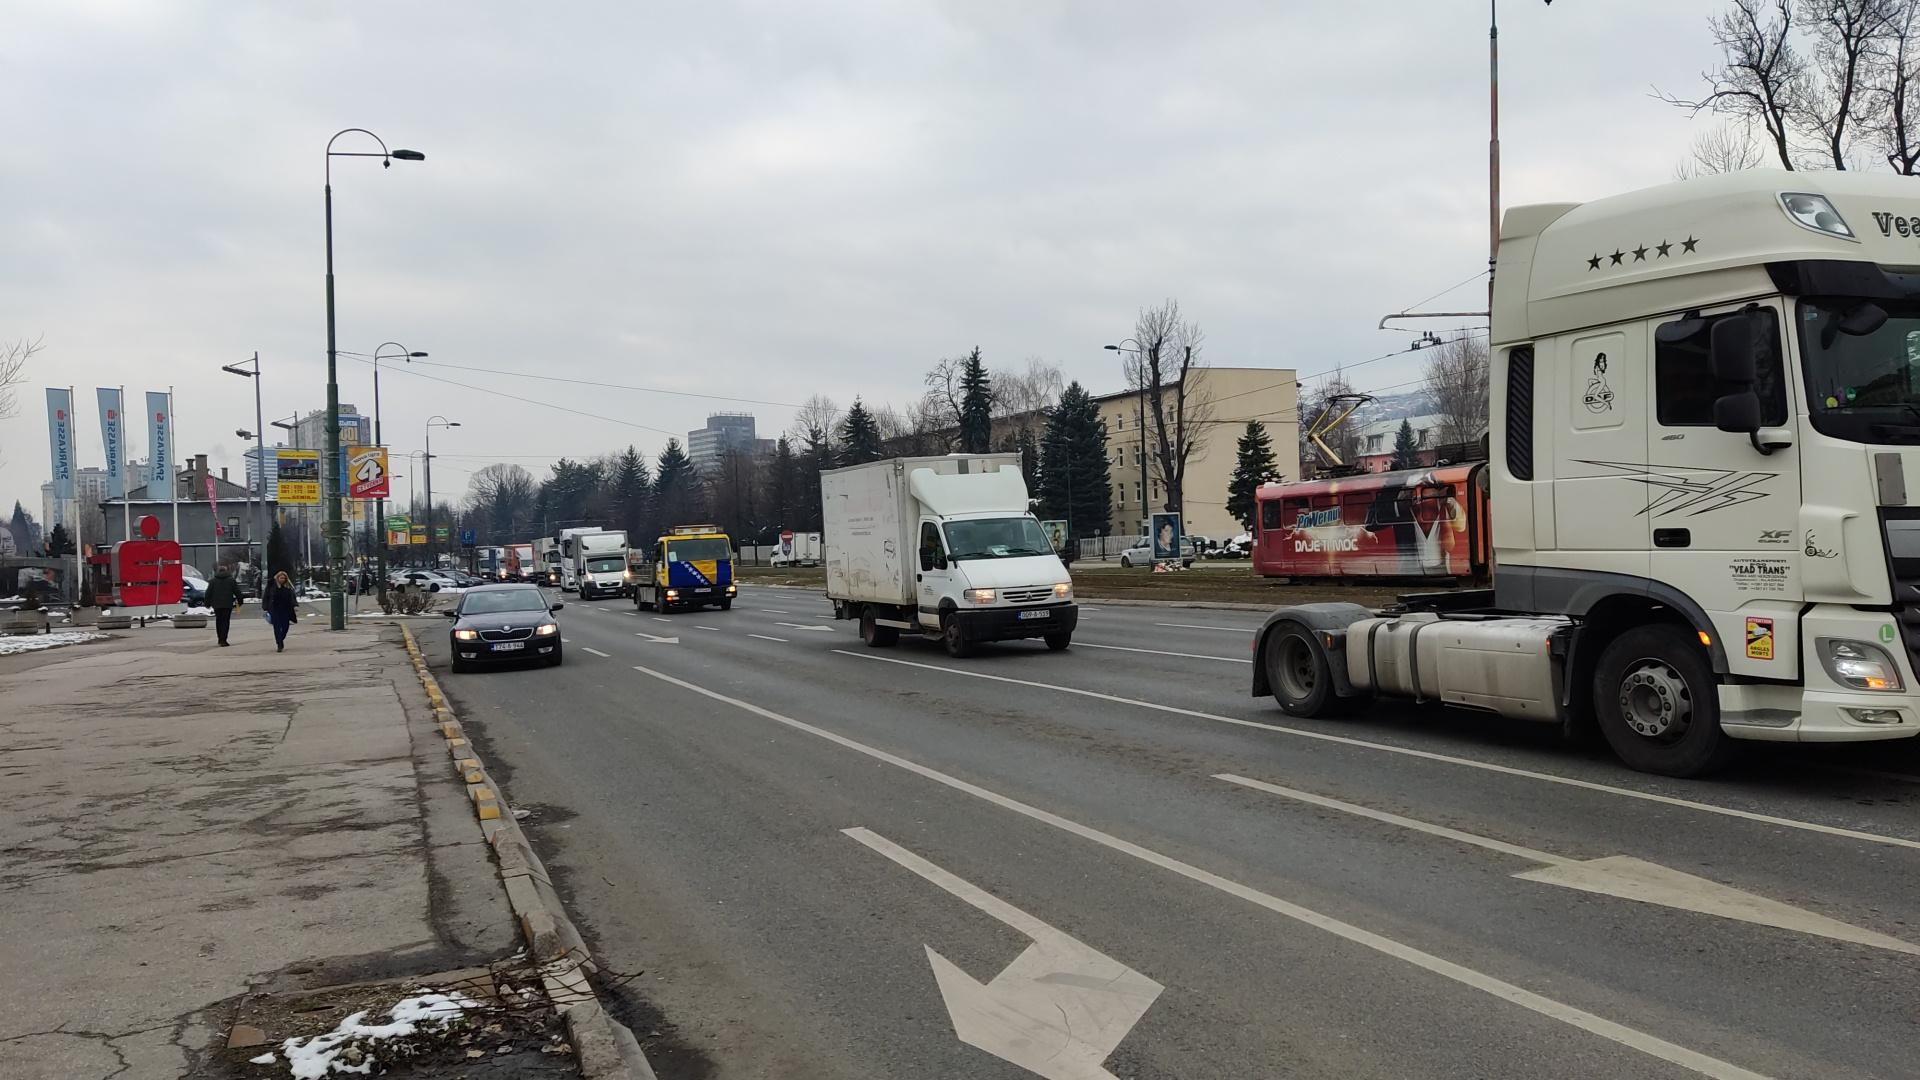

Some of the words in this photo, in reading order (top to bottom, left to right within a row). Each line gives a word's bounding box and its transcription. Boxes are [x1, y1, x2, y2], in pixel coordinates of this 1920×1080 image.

[356, 459, 383, 482] 4
[1760, 530, 1792, 538] XF
[1295, 540, 1321, 552] DAJE
[1882, 626, 1893, 641] L
